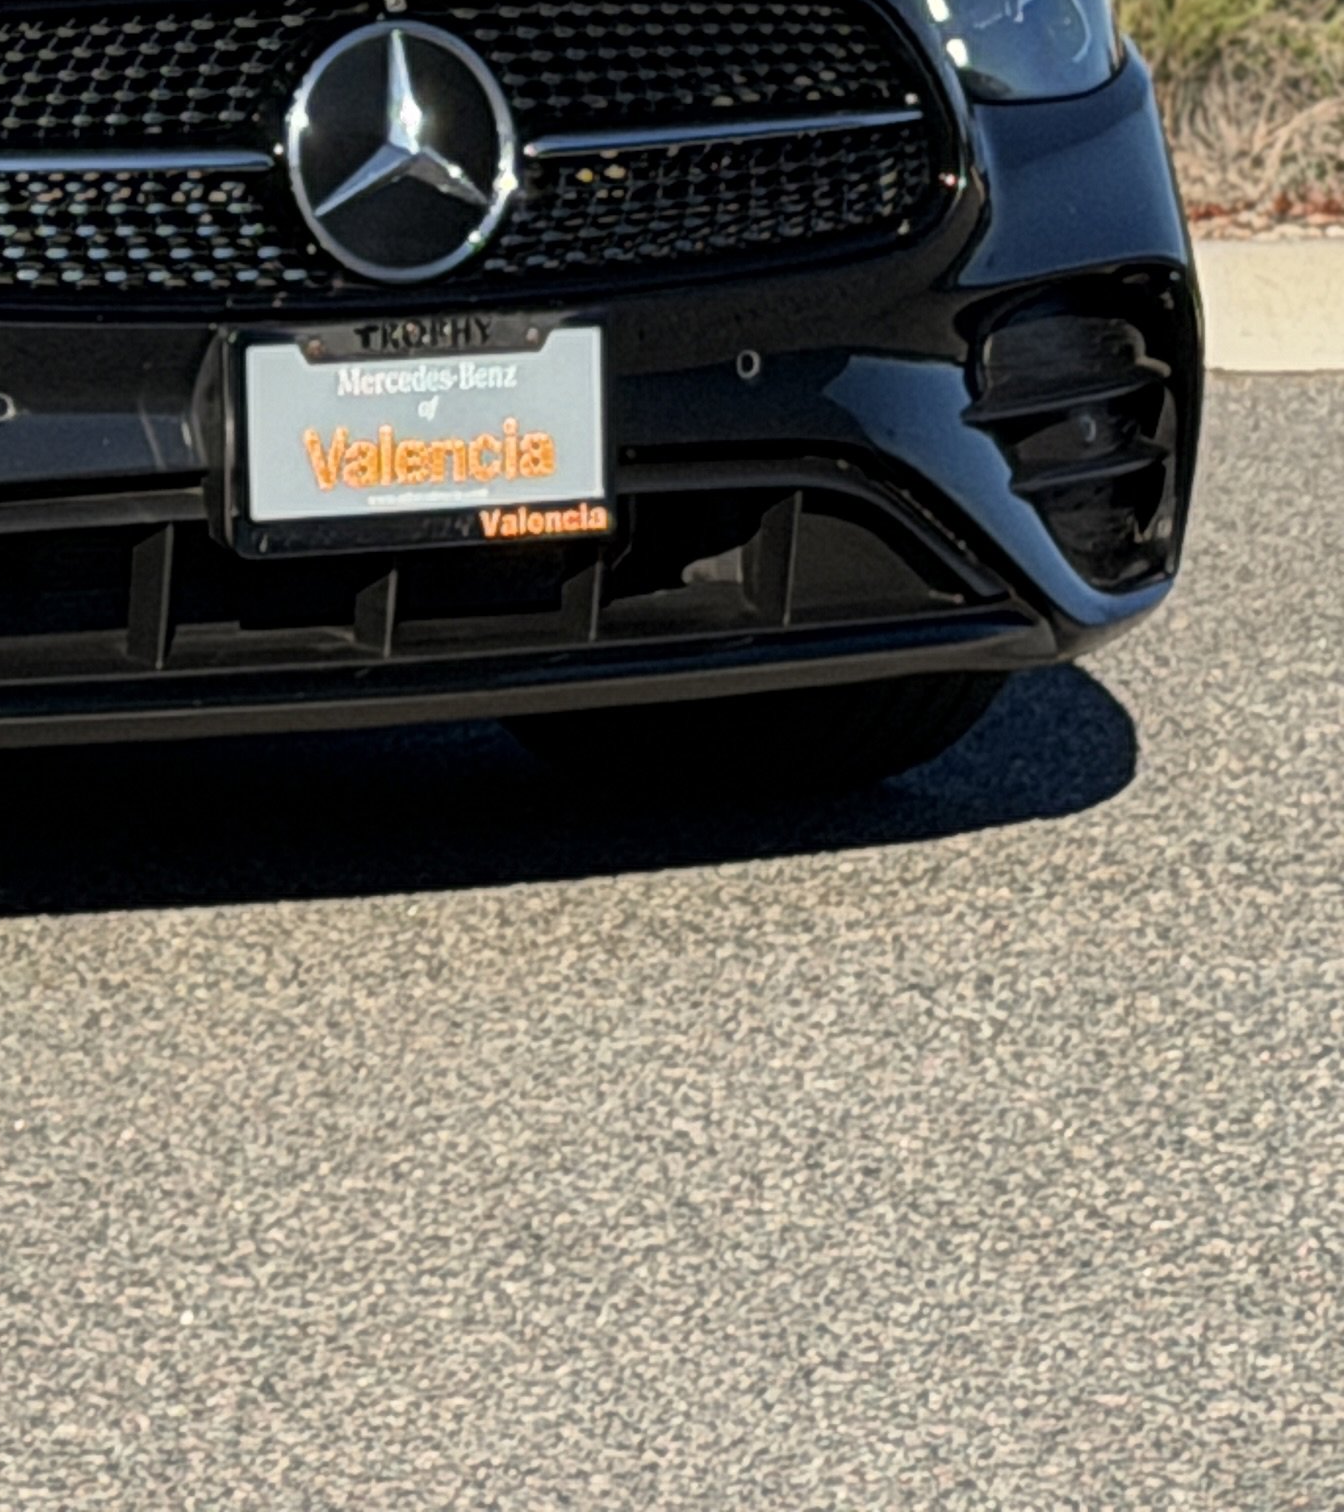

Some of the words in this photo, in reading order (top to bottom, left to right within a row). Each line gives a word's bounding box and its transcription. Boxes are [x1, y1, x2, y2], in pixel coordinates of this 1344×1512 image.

[337, 361, 518, 396] Mercedes-Benz
[417, 395, 440, 422] of
[304, 417, 555, 491] Valencia
[479, 502, 609, 538] Valencia
